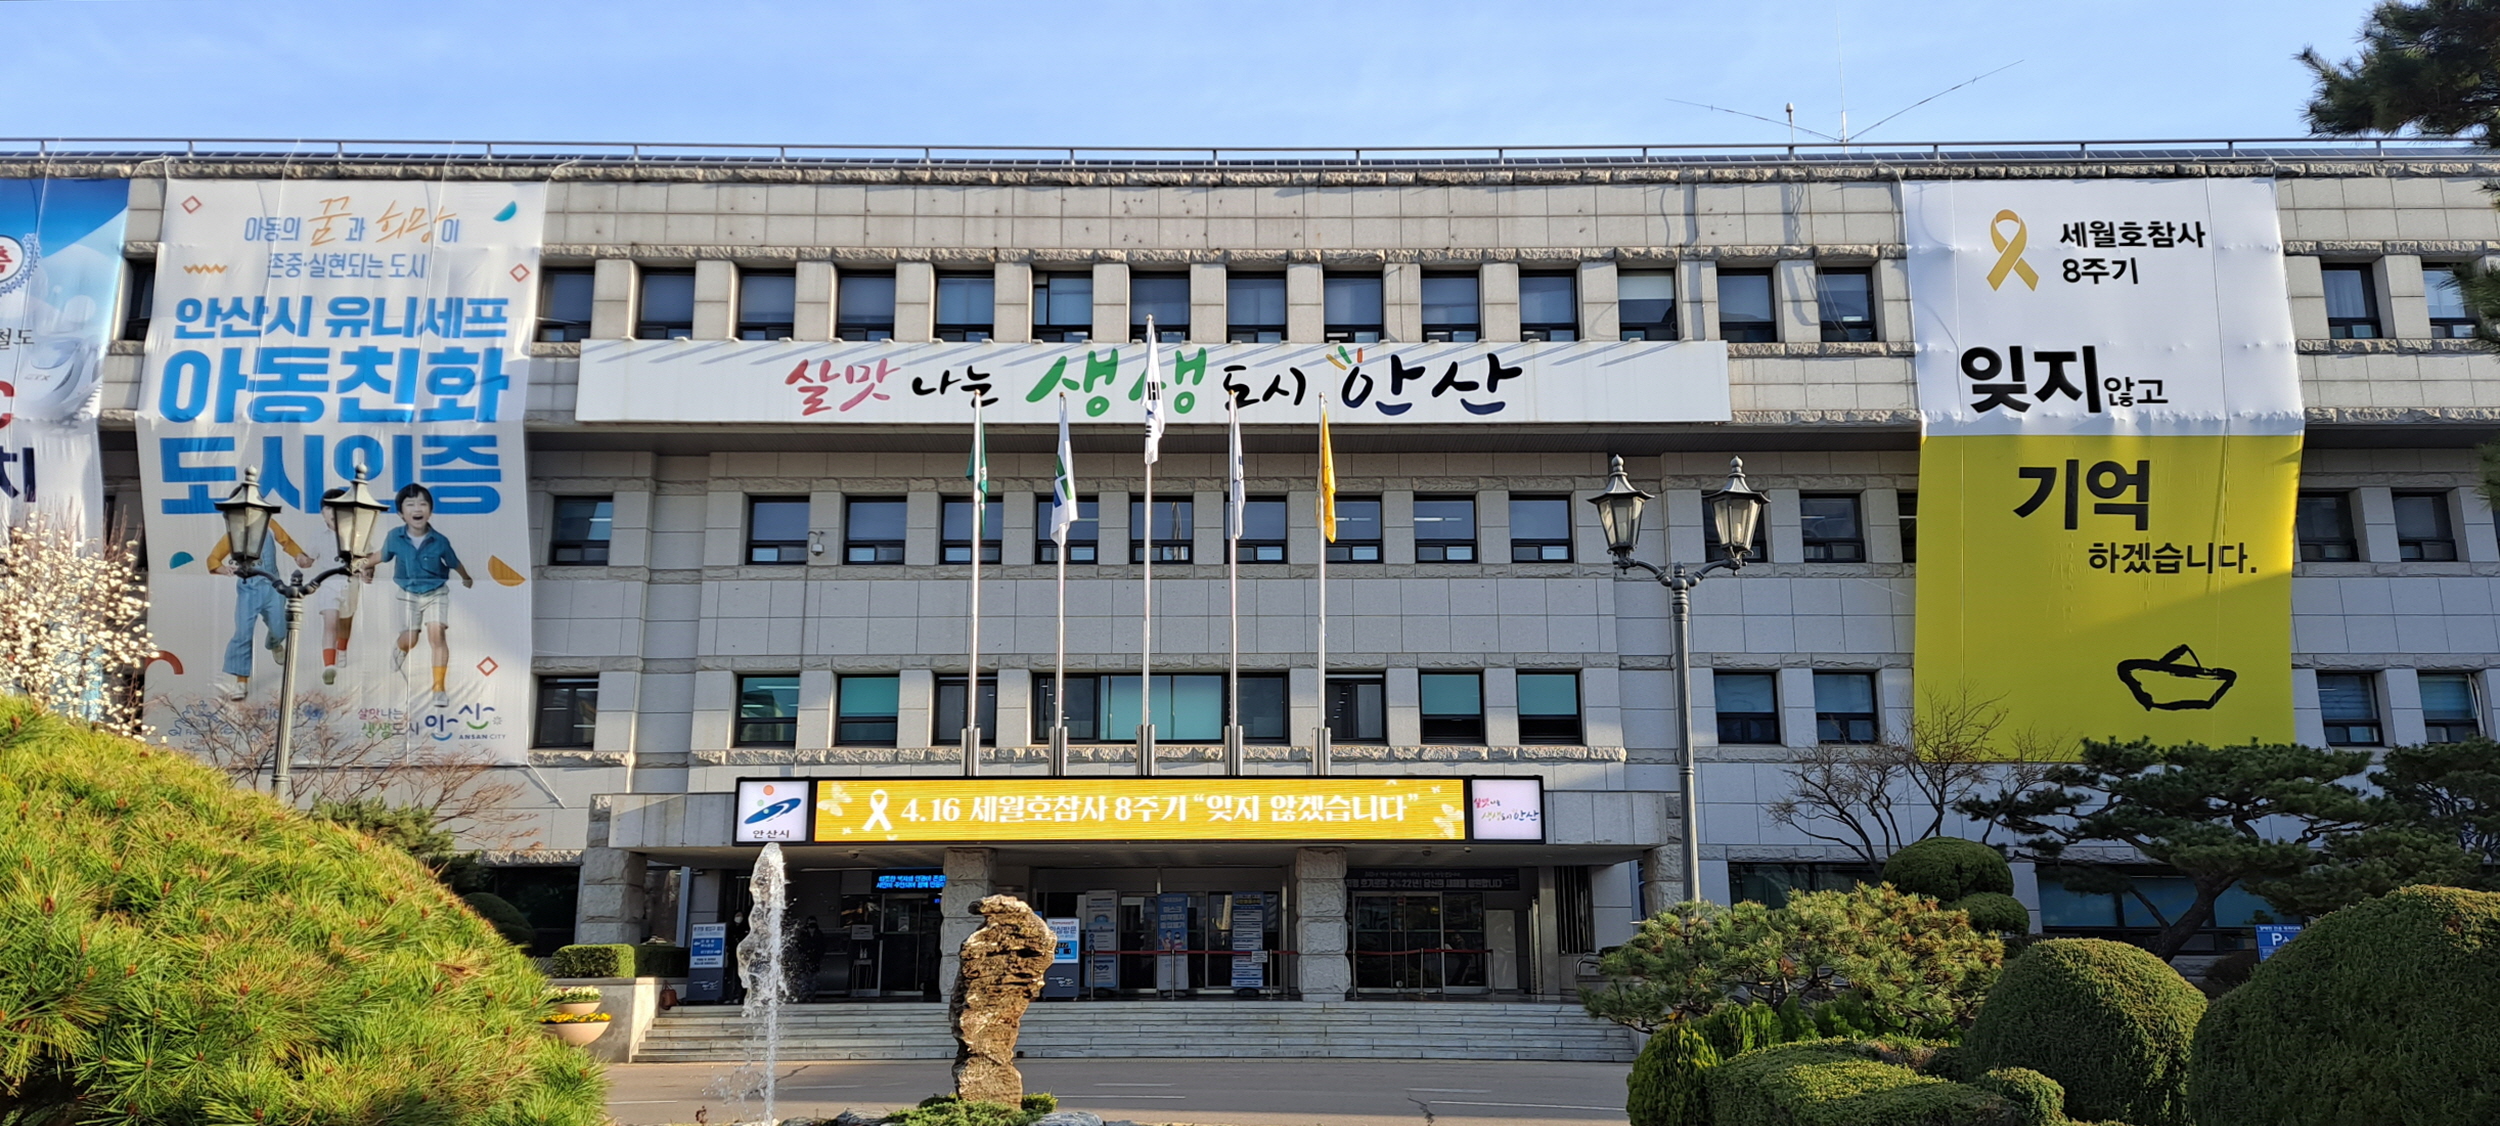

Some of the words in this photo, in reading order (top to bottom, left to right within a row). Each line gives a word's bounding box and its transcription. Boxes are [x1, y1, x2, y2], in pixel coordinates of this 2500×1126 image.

[244, 216, 302, 242] 아동의
[2059, 220, 2206, 249] 세월호참사
[388, 254, 427, 279] 도시
[2061, 257, 2140, 285] 8주기
[173, 295, 314, 340] 안산시
[324, 296, 510, 339] 유니세프
[158, 345, 510, 424] 아동친화
[1340, 352, 1524, 417] 안산
[1960, 345, 2103, 414] 잊지
[2103, 376, 2169, 408] 않고
[159, 434, 502, 515] 도시인증
[2013, 458, 2151, 531] 기억
[2088, 542, 2258, 575] 하겠습니다.
[901, 797, 961, 823] 4.16
[970, 795, 1109, 823] 세월호참사
[1114, 794, 1188, 823] 8주기
[1513, 809, 1539, 822] 안산
[752, 829, 791, 839] 안산시
[2271, 932, 2283, 946] P
